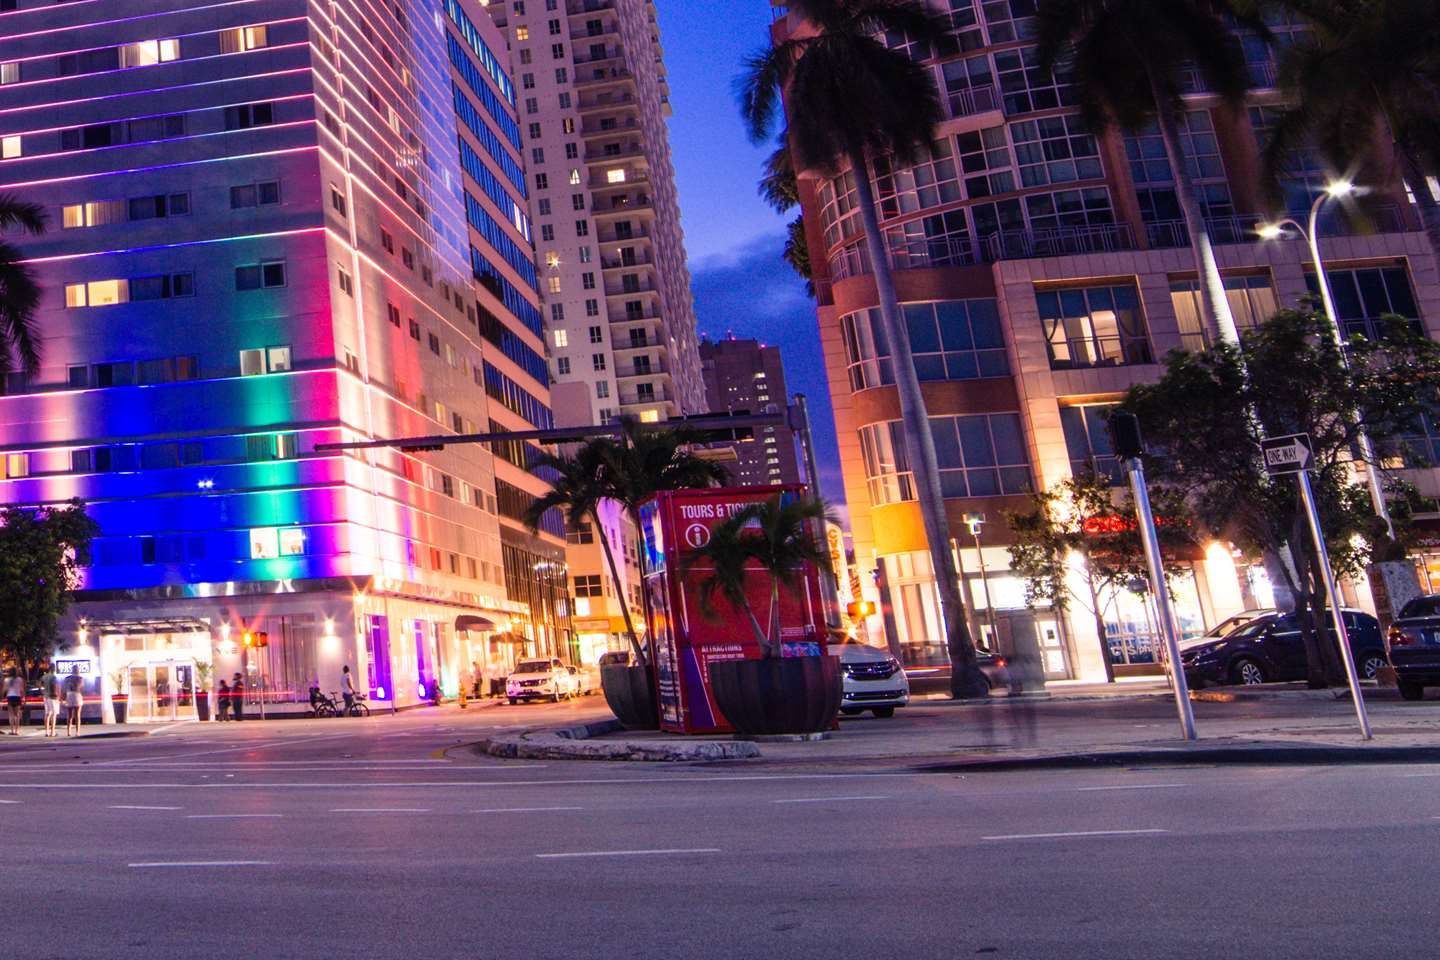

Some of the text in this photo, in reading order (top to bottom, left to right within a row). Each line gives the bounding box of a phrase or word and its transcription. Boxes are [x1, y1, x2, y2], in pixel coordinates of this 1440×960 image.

[1268, 447, 1297, 464] ONE WAY
[680, 504, 715, 519] TOURS
[716, 503, 724, 517] &
